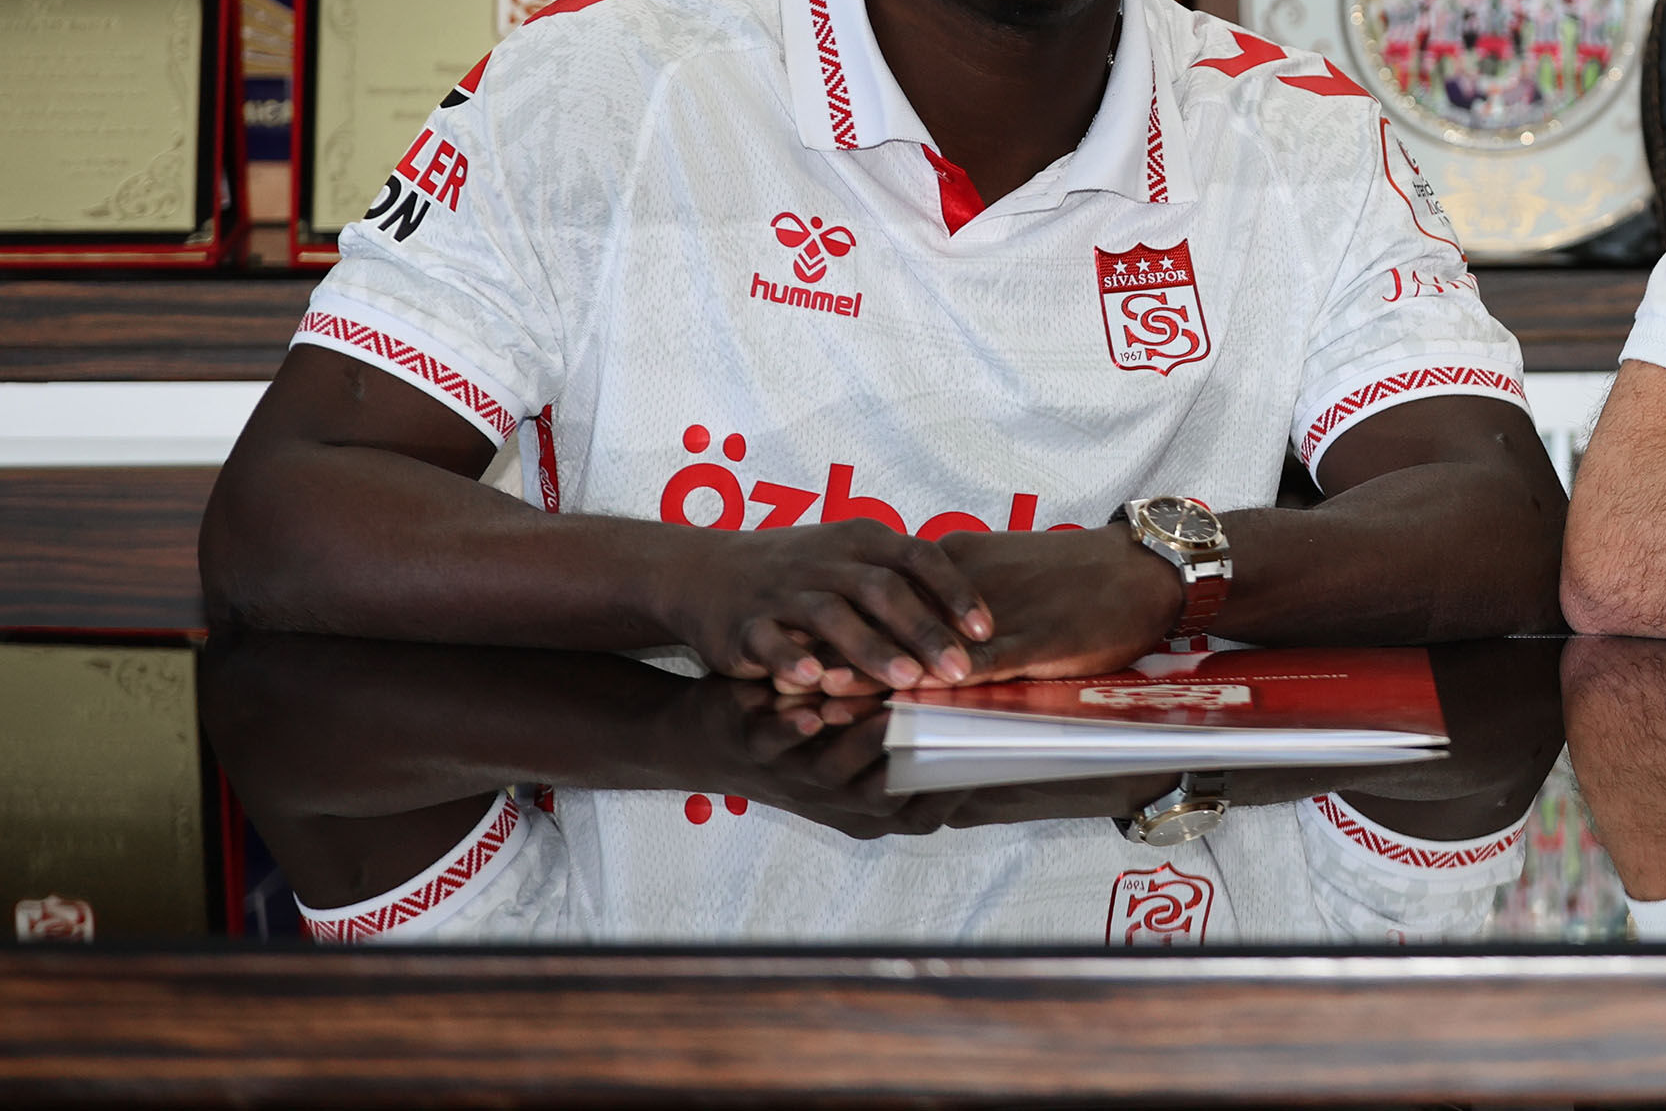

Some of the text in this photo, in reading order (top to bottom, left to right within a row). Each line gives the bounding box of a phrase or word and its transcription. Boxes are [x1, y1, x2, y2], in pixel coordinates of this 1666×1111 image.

[1103, 270, 1188, 287] SİVASSPOR
[750, 272, 862, 318] hummel
[1119, 350, 1142, 362] 1967
